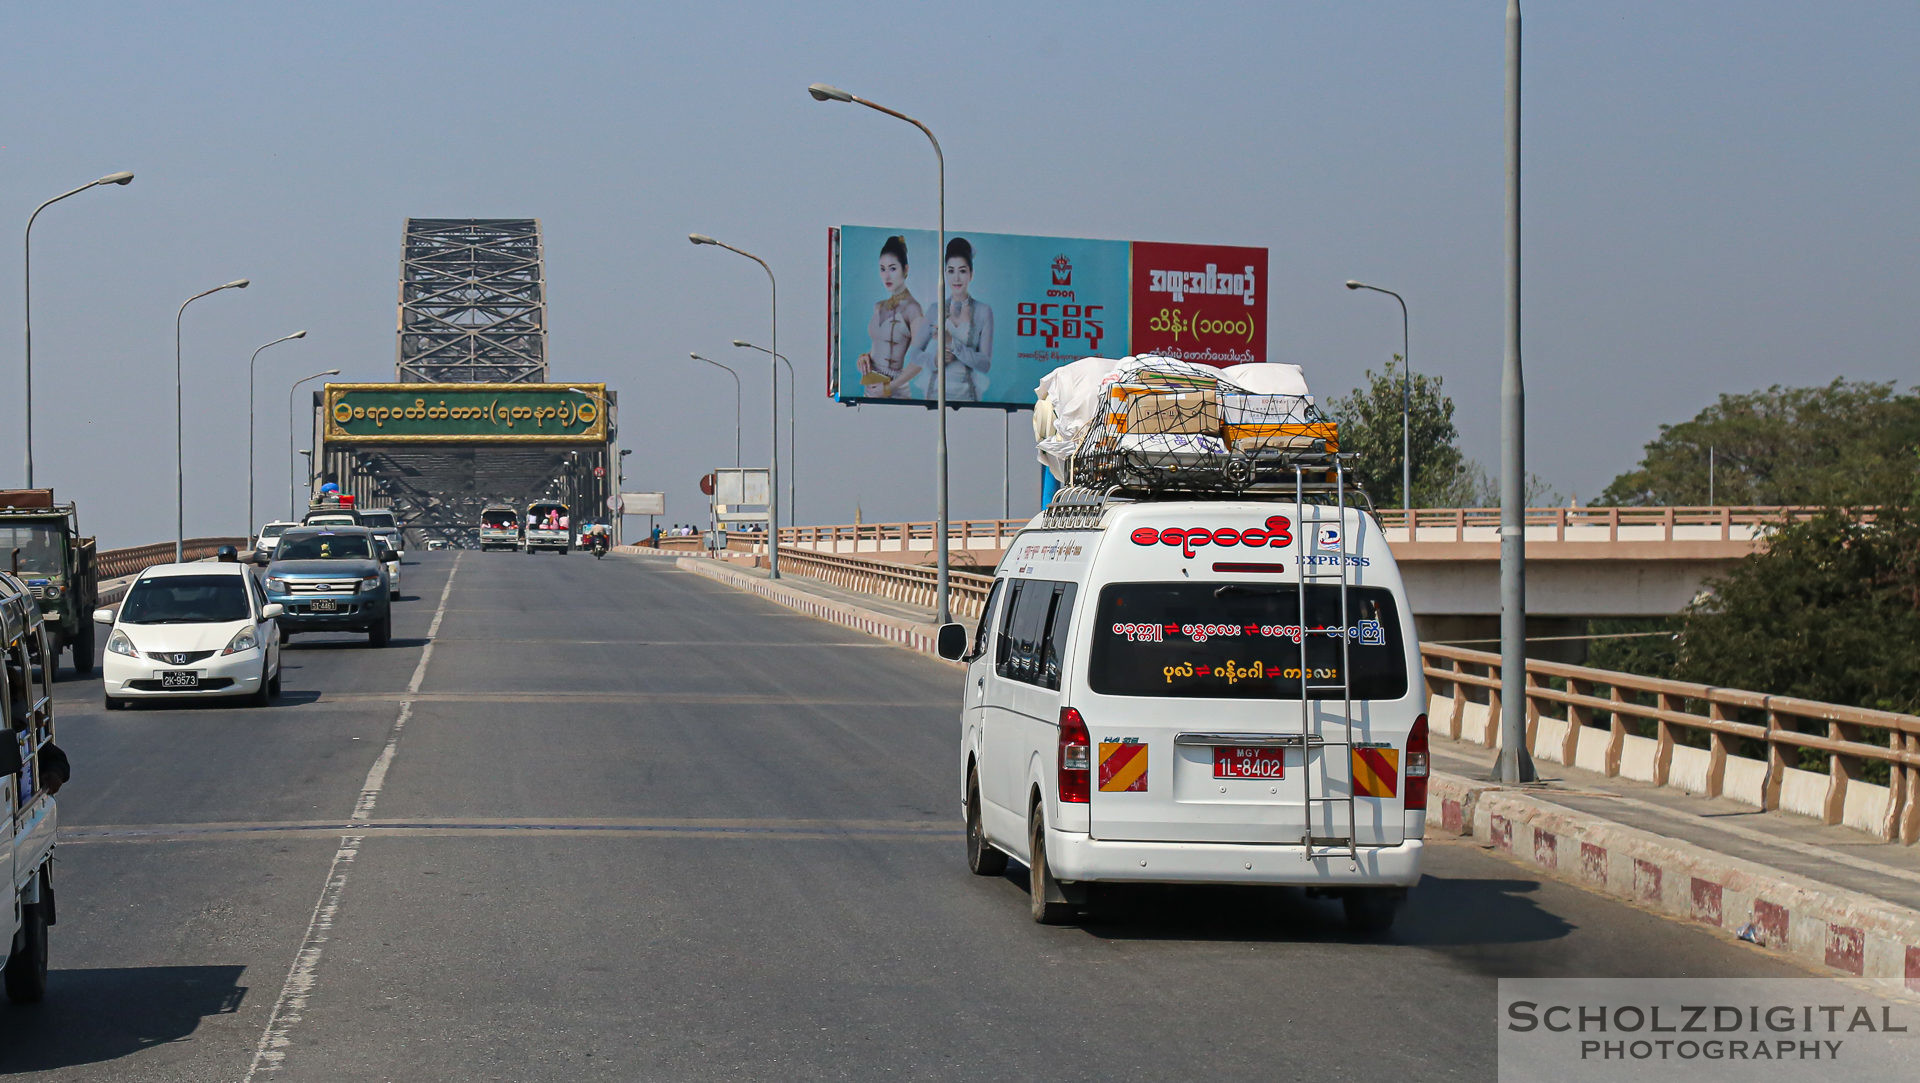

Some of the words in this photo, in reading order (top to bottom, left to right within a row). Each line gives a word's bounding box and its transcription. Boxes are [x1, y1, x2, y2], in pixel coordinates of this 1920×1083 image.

[1149, 263, 1255, 305] အထူးအစီအစဉ်
[1046, 289, 1075, 302] ထာဝရ
[1130, 515, 1293, 560] ဧရာဝတီ
[1112, 622, 1163, 642] ပခုက္ကူ
[1182, 623, 1241, 642] မန္တလေး
[164, 675, 196, 686] 2K-9573
[1163, 661, 1194, 683] ပုလဲ
[1236, 748, 1260, 758] MGY
[1219, 758, 1280, 777] 1L-8402
